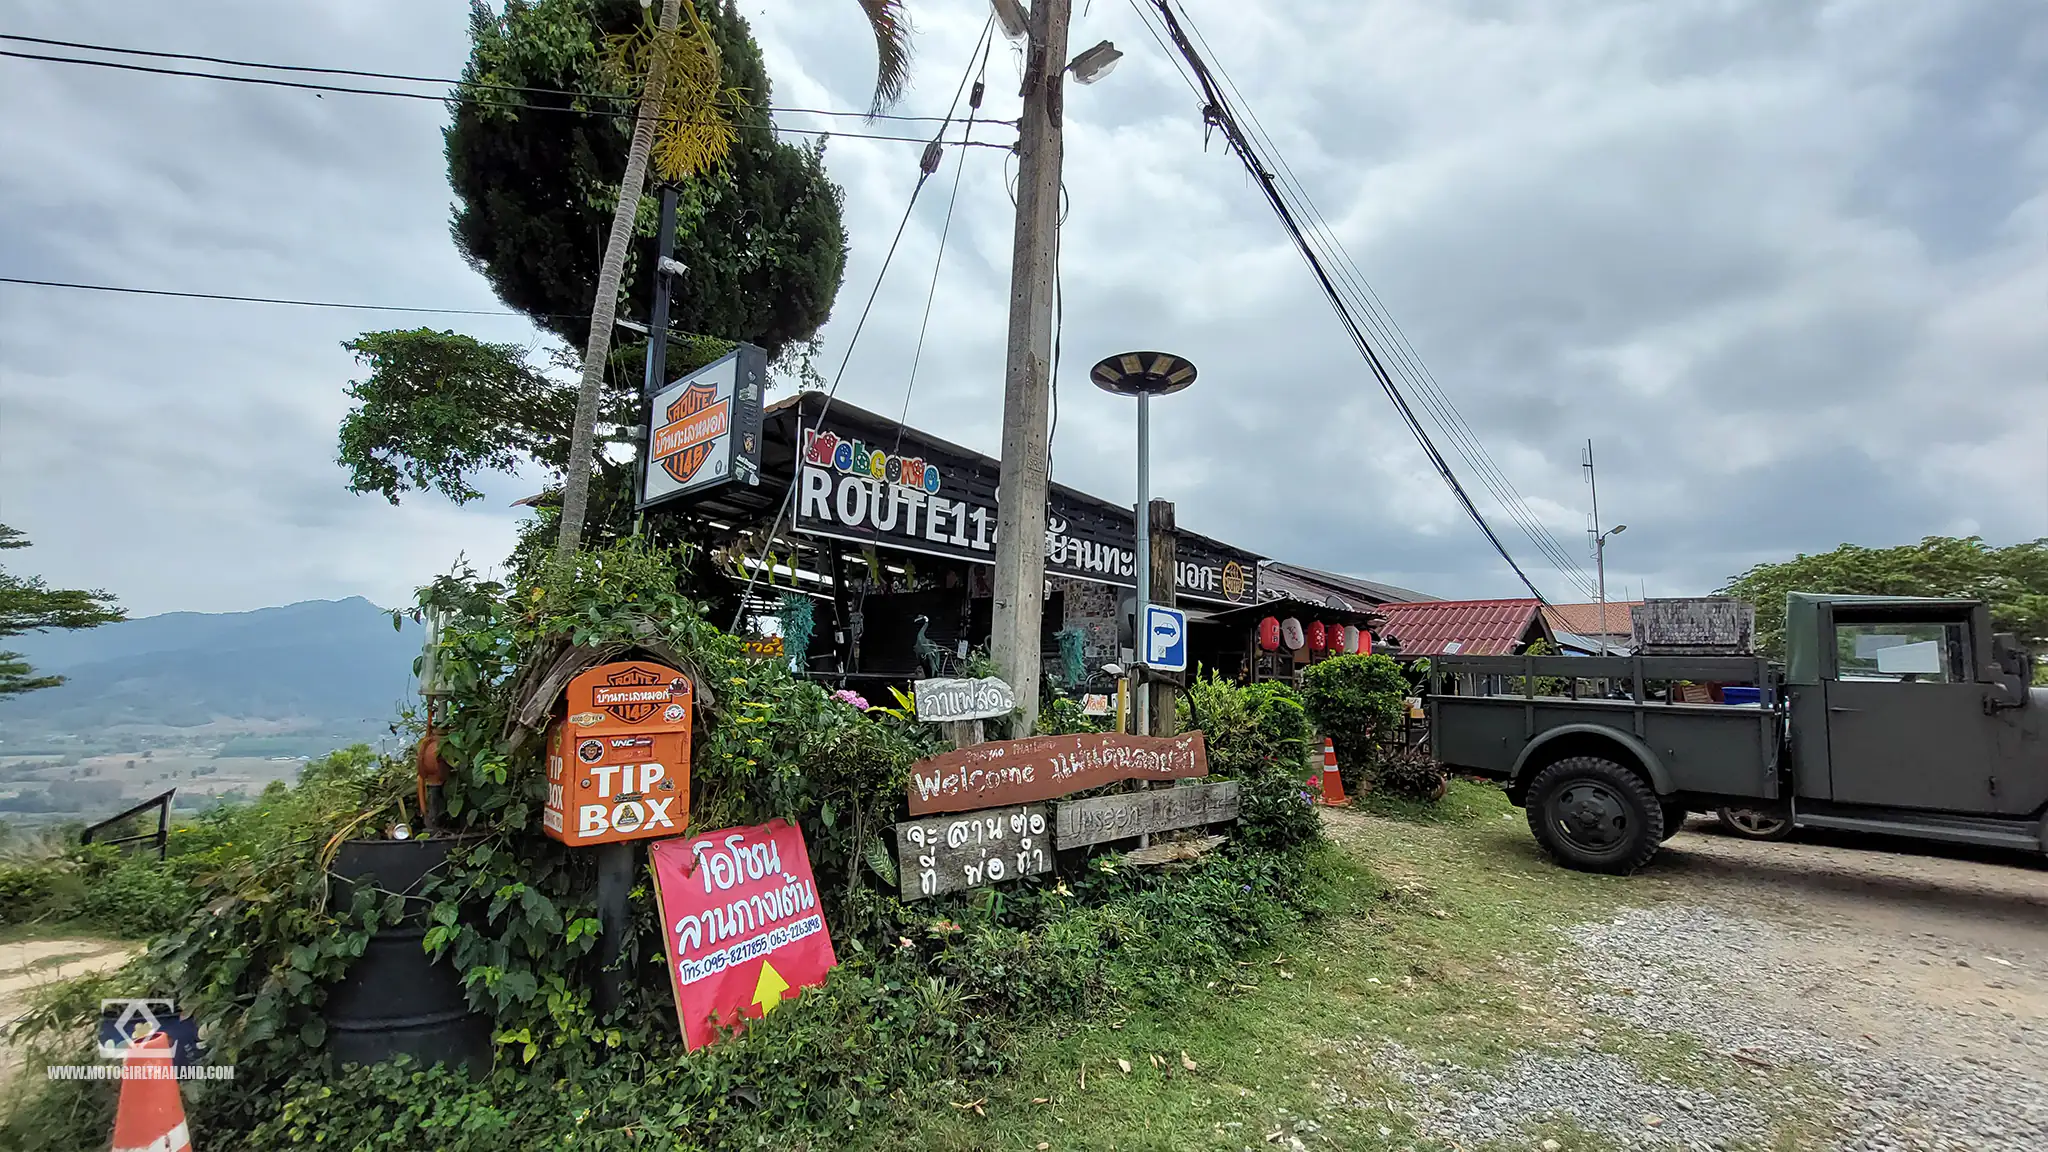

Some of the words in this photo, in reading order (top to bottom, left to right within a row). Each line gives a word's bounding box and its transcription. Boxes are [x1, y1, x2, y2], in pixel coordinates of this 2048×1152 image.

[674, 393, 711, 421] ROUTE
[655, 411, 726, 455] บ้านทะเลหมอก
[800, 465, 998, 551] ROUTE11
[596, 688, 670, 703] บ้านทะเลหมอก
[615, 673, 653, 685] ROUTE
[550, 755, 563, 780] TIP
[590, 763, 665, 798] TIP
[914, 764, 1036, 800] Welcome
[579, 797, 675, 838] BOX
[907, 825, 938, 848] จะ
[947, 816, 1003, 849] สาน
[1010, 806, 1046, 837] ต่อ
[693, 835, 781, 894] โอโซน
[918, 845, 937, 895] ที่
[964, 848, 1005, 886] พ่อ
[675, 872, 815, 956] ลานกางเต้น
